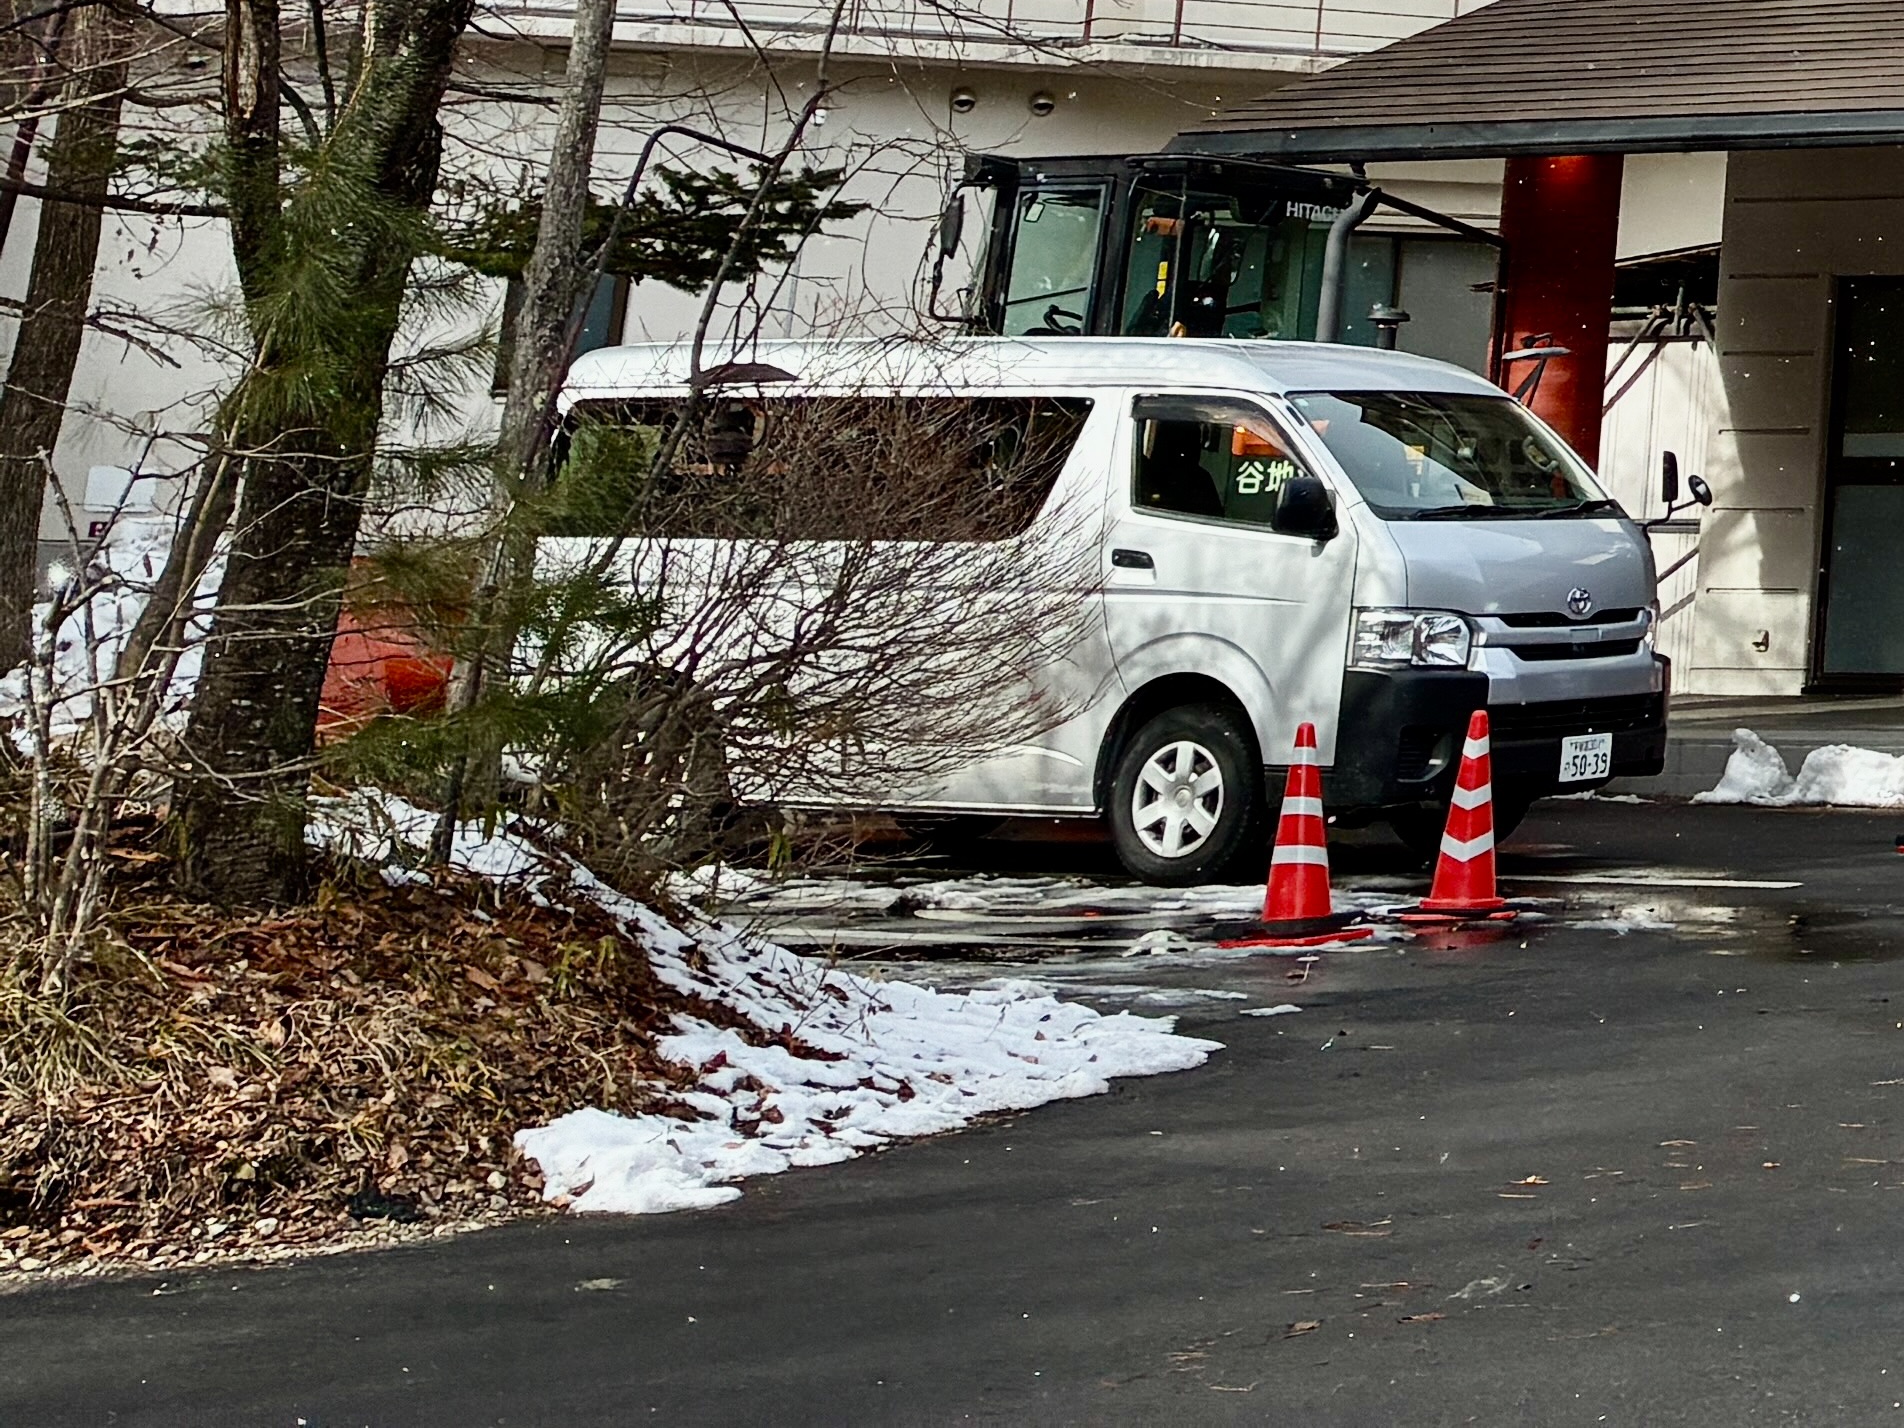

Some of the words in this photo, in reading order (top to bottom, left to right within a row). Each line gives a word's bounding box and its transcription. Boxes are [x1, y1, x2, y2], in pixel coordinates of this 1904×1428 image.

[1286, 201, 1346, 221] HITACH
[1236, 460, 1304, 495] 谷地
[1571, 752, 1608, 777] 50-39
